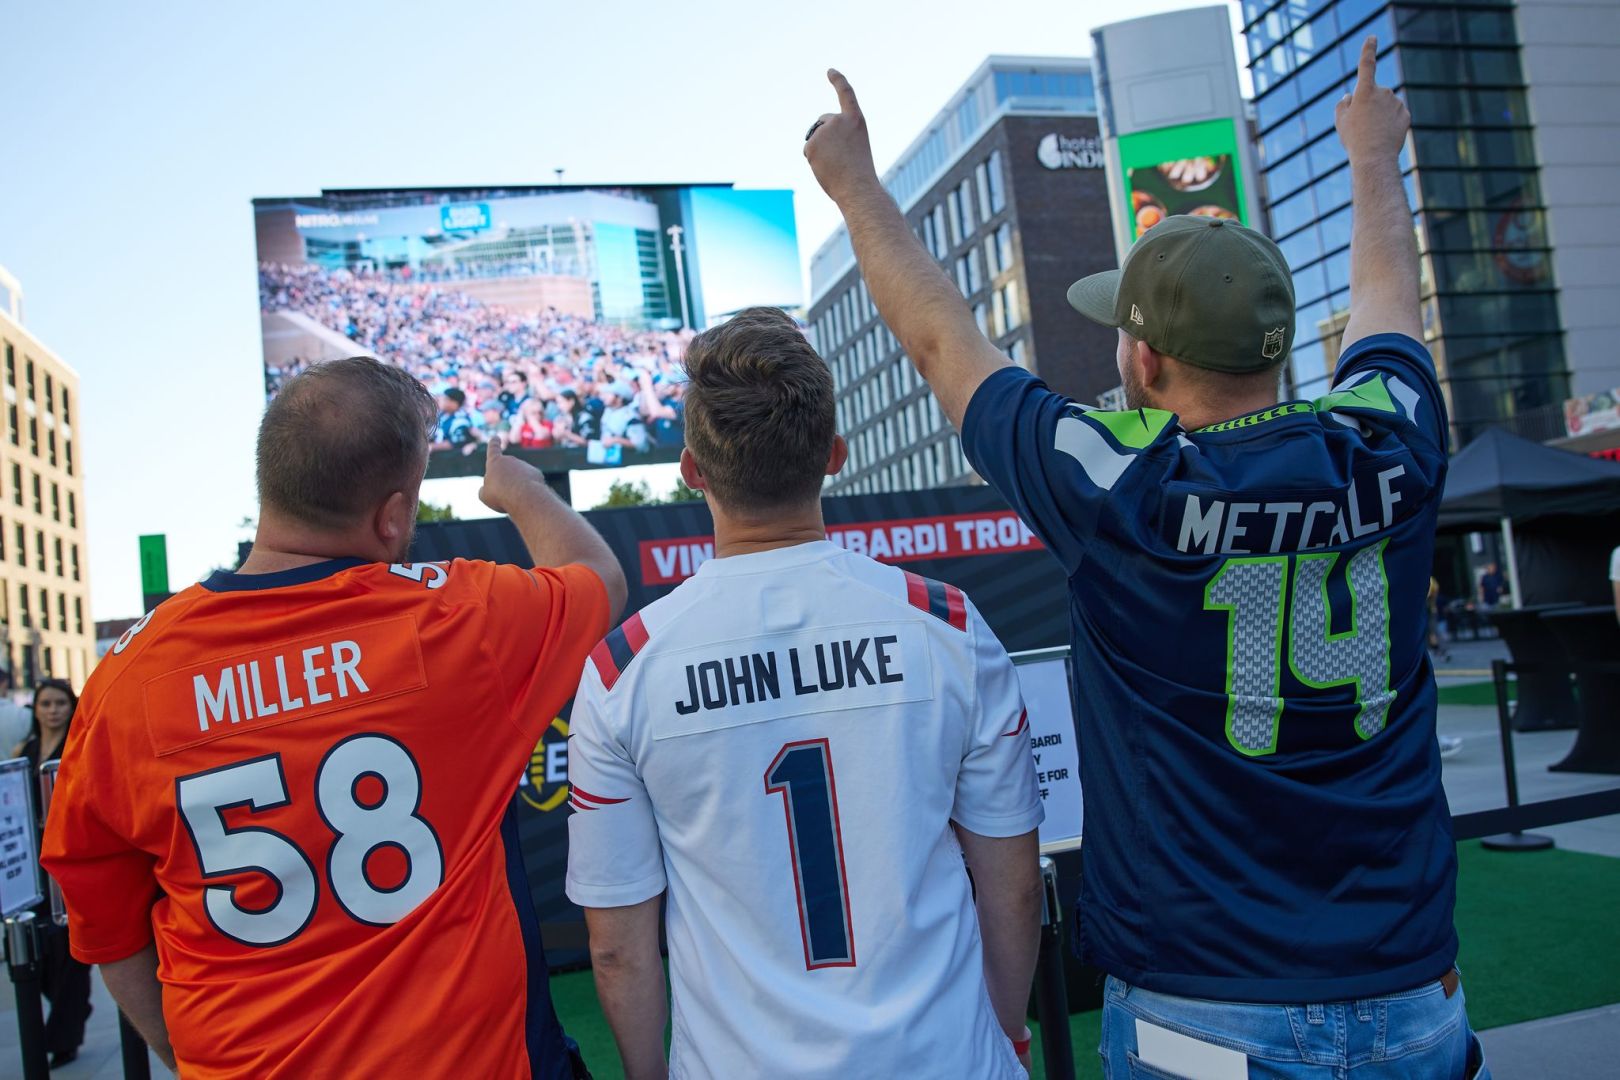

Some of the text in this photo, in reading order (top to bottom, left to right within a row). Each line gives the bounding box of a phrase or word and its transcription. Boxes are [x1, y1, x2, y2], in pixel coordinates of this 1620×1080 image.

[1062, 151, 1104, 168] INDI
[651, 542, 714, 578] VIN
[955, 516, 1036, 551] TROP
[1176, 464, 1406, 555] METCALF
[192, 639, 370, 732] MILLER
[675, 634, 904, 716] JOHN LUKE
[1203, 536, 1398, 757] 14
[1031, 733, 1062, 749] BARDI
[1047, 768, 1069, 783] FOR
[175, 731, 446, 949] 58
[763, 737, 857, 971] 1
